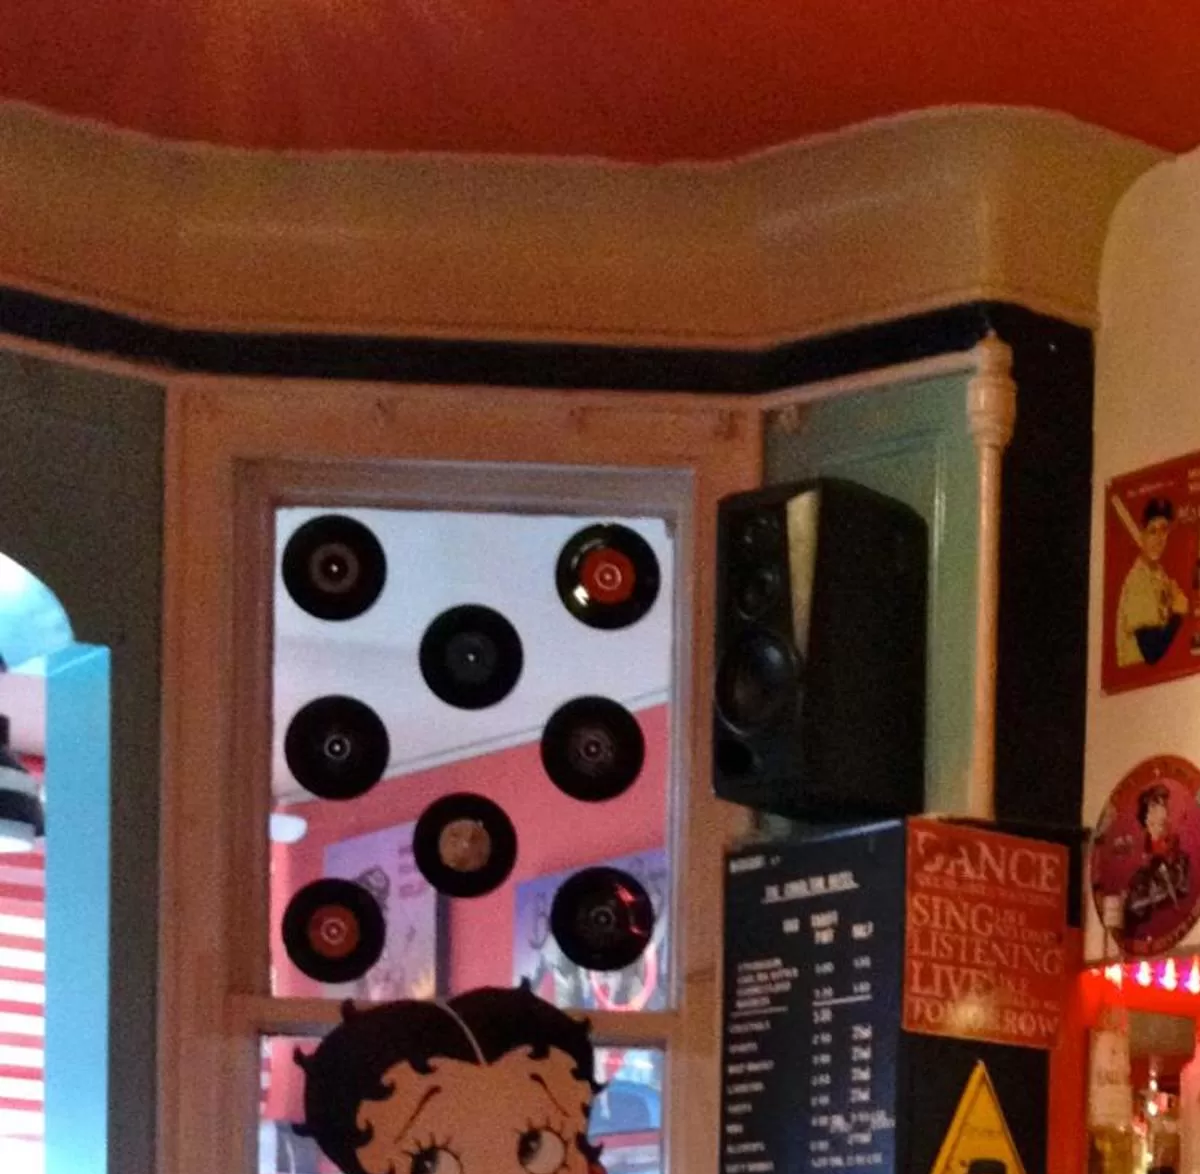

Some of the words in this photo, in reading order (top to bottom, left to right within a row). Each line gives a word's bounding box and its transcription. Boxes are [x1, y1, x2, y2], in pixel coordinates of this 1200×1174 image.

[915, 829, 1062, 894] DANCE
[911, 893, 994, 937] SING
[911, 930, 1064, 976] LISTENING
